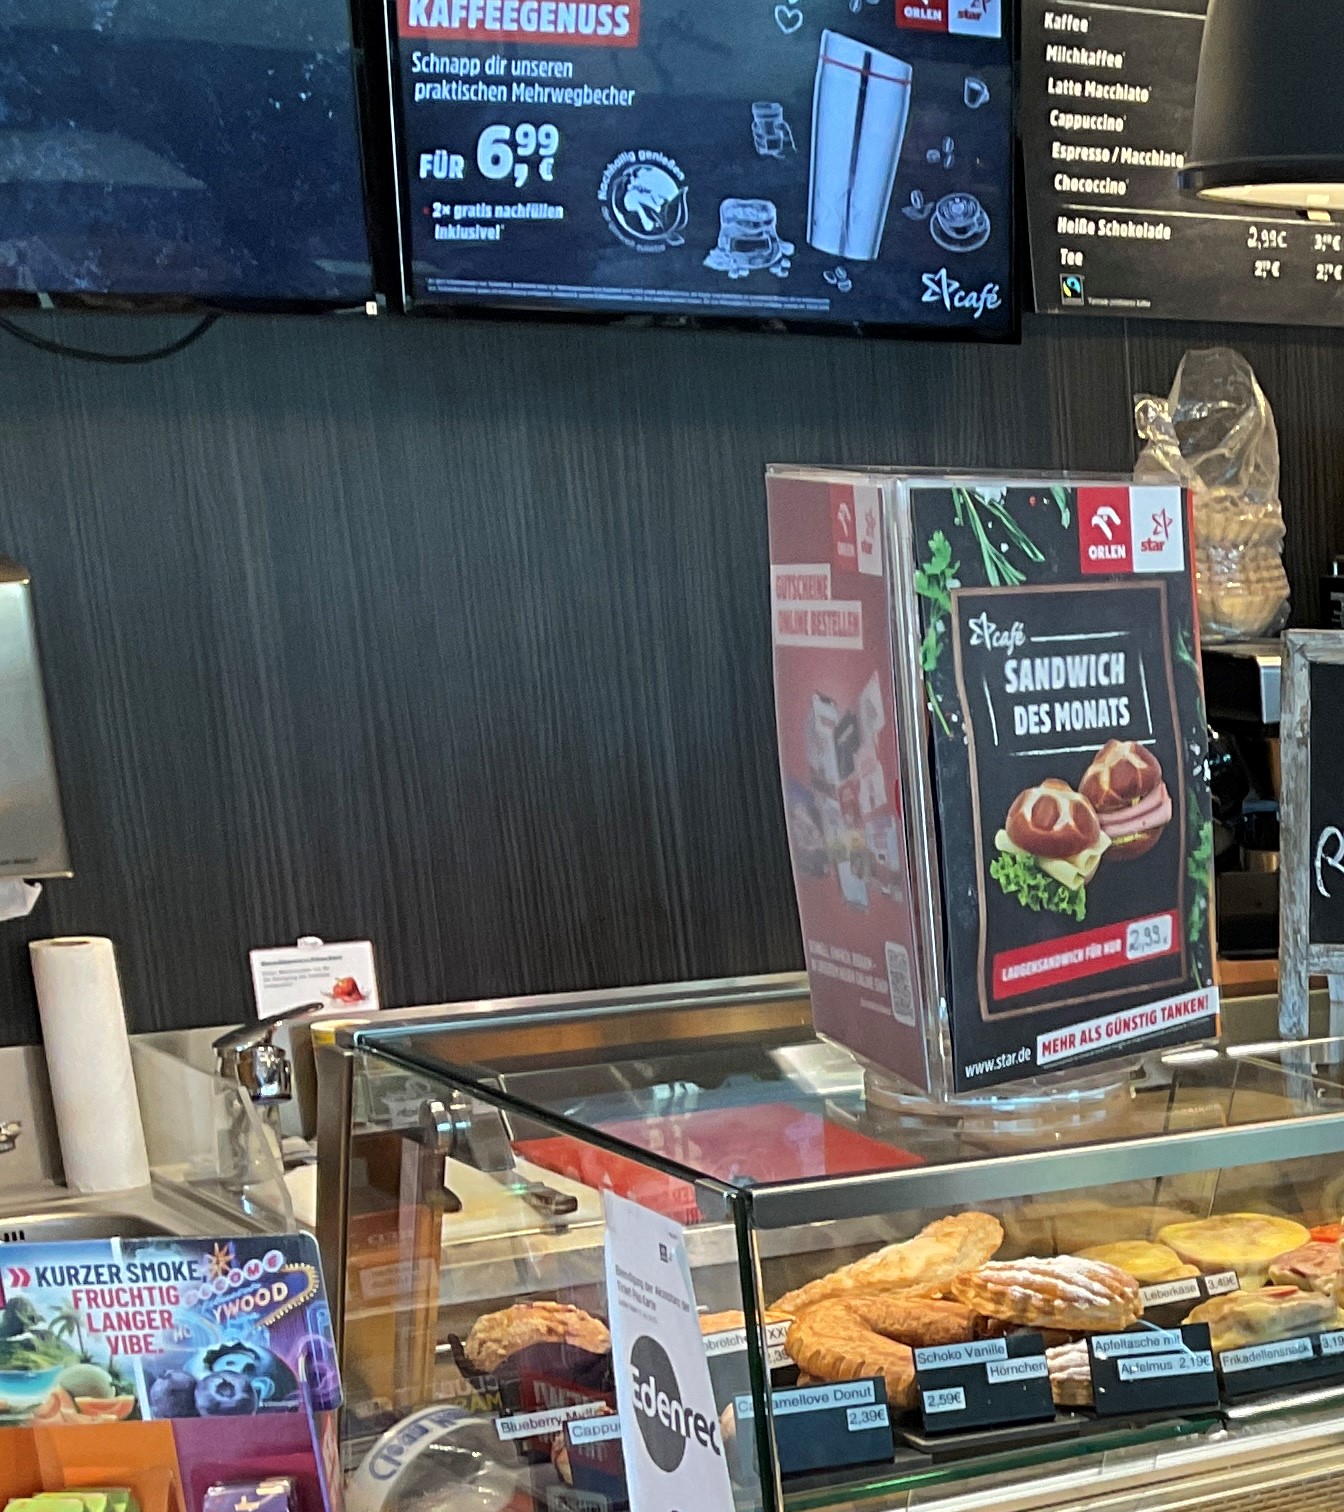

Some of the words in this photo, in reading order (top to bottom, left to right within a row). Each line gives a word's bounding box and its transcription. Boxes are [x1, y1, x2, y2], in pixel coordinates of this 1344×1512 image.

[408, 0, 630, 36] KAFFEEGENUSS
[903, 6, 943, 21] ORLEN
[411, 51, 481, 77] Schnapp
[485, 54, 506, 76] dir
[511, 59, 573, 78] unseren
[414, 80, 507, 103] praktischen
[511, 81, 636, 107] Mehrwegbecher
[419, 150, 465, 180] FÜR
[453, 202, 492, 220] gratis
[1059, 247, 1084, 267] Tee
[1088, 544, 1127, 560] ORLEN
[1005, 651, 1126, 693] SANDWICH
[1013, 701, 1052, 736] DES
[1054, 696, 1131, 731] MONATS
[1041, 1036, 1076, 1058] MEHR
[1079, 1028, 1102, 1047] ALS
[1105, 1010, 1158, 1037] GÜNSTIG
[1160, 994, 1210, 1023] TANKEN!
[965, 1045, 1032, 1079] www.star.de
[36, 1262, 123, 1289] KURZER
[127, 1259, 209, 1285] SMOKE,
[72, 1283, 182, 1310] FRUCHTIG
[87, 1310, 176, 1334] LANGER
[105, 1331, 165, 1357] VIBE.
[916, 1347, 963, 1366] Schoko
[832, 1384, 874, 1404] Donut
[848, 1408, 888, 1428] 2,39€
